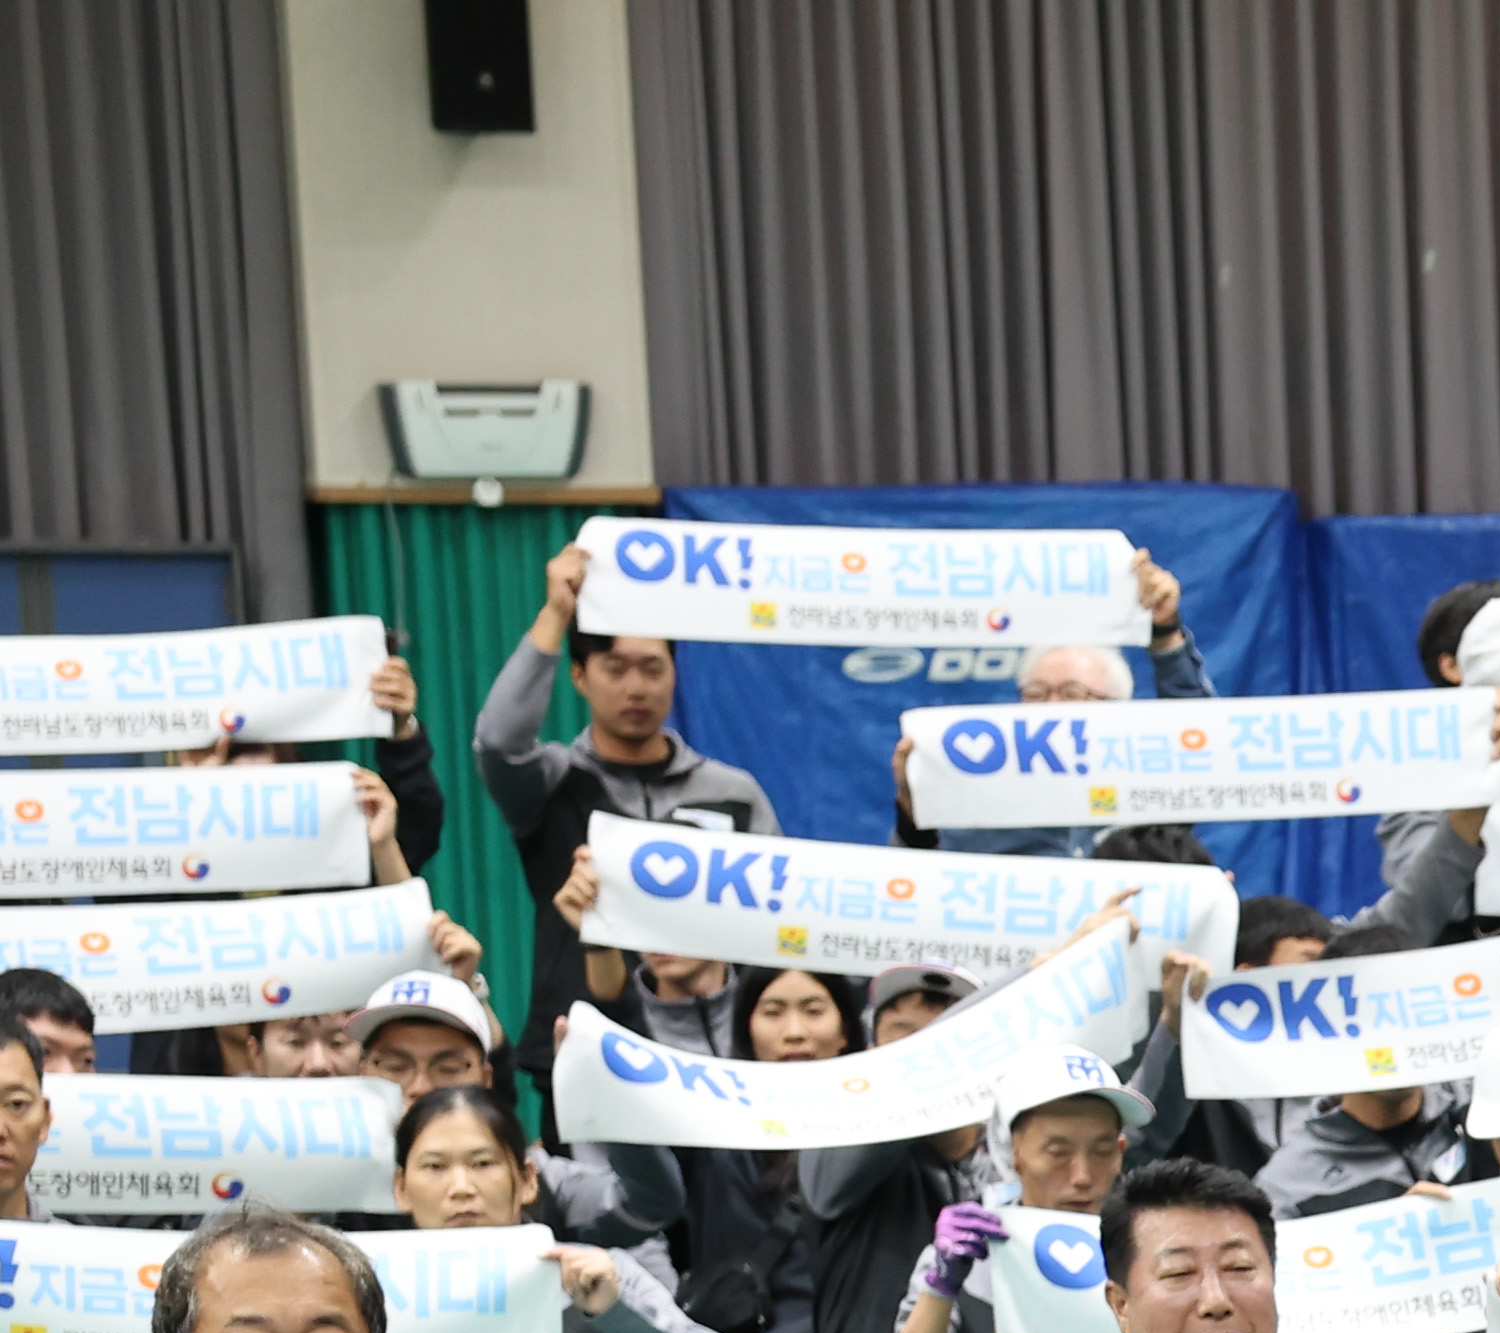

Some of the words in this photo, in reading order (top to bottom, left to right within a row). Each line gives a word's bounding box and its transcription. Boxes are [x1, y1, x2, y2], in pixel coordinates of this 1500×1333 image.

[616, 530, 754, 590] OK!
[762, 553, 872, 592] 지금은
[888, 541, 1108, 597] 전남시대
[105, 632, 349, 703] 전남시대
[942, 718, 1089, 775] OK!
[1099, 728, 1211, 772] 지금은
[1228, 704, 1463, 772] 전남시대
[68, 780, 319, 846] 전남시대
[631, 841, 789, 913] OK!
[796, 874, 917, 923] 지금은
[134, 899, 405, 976] 전남시대
[1205, 975, 1360, 1042] OK!
[1367, 973, 1491, 1029] 지금은
[79, 1093, 370, 1158] 전남시대
